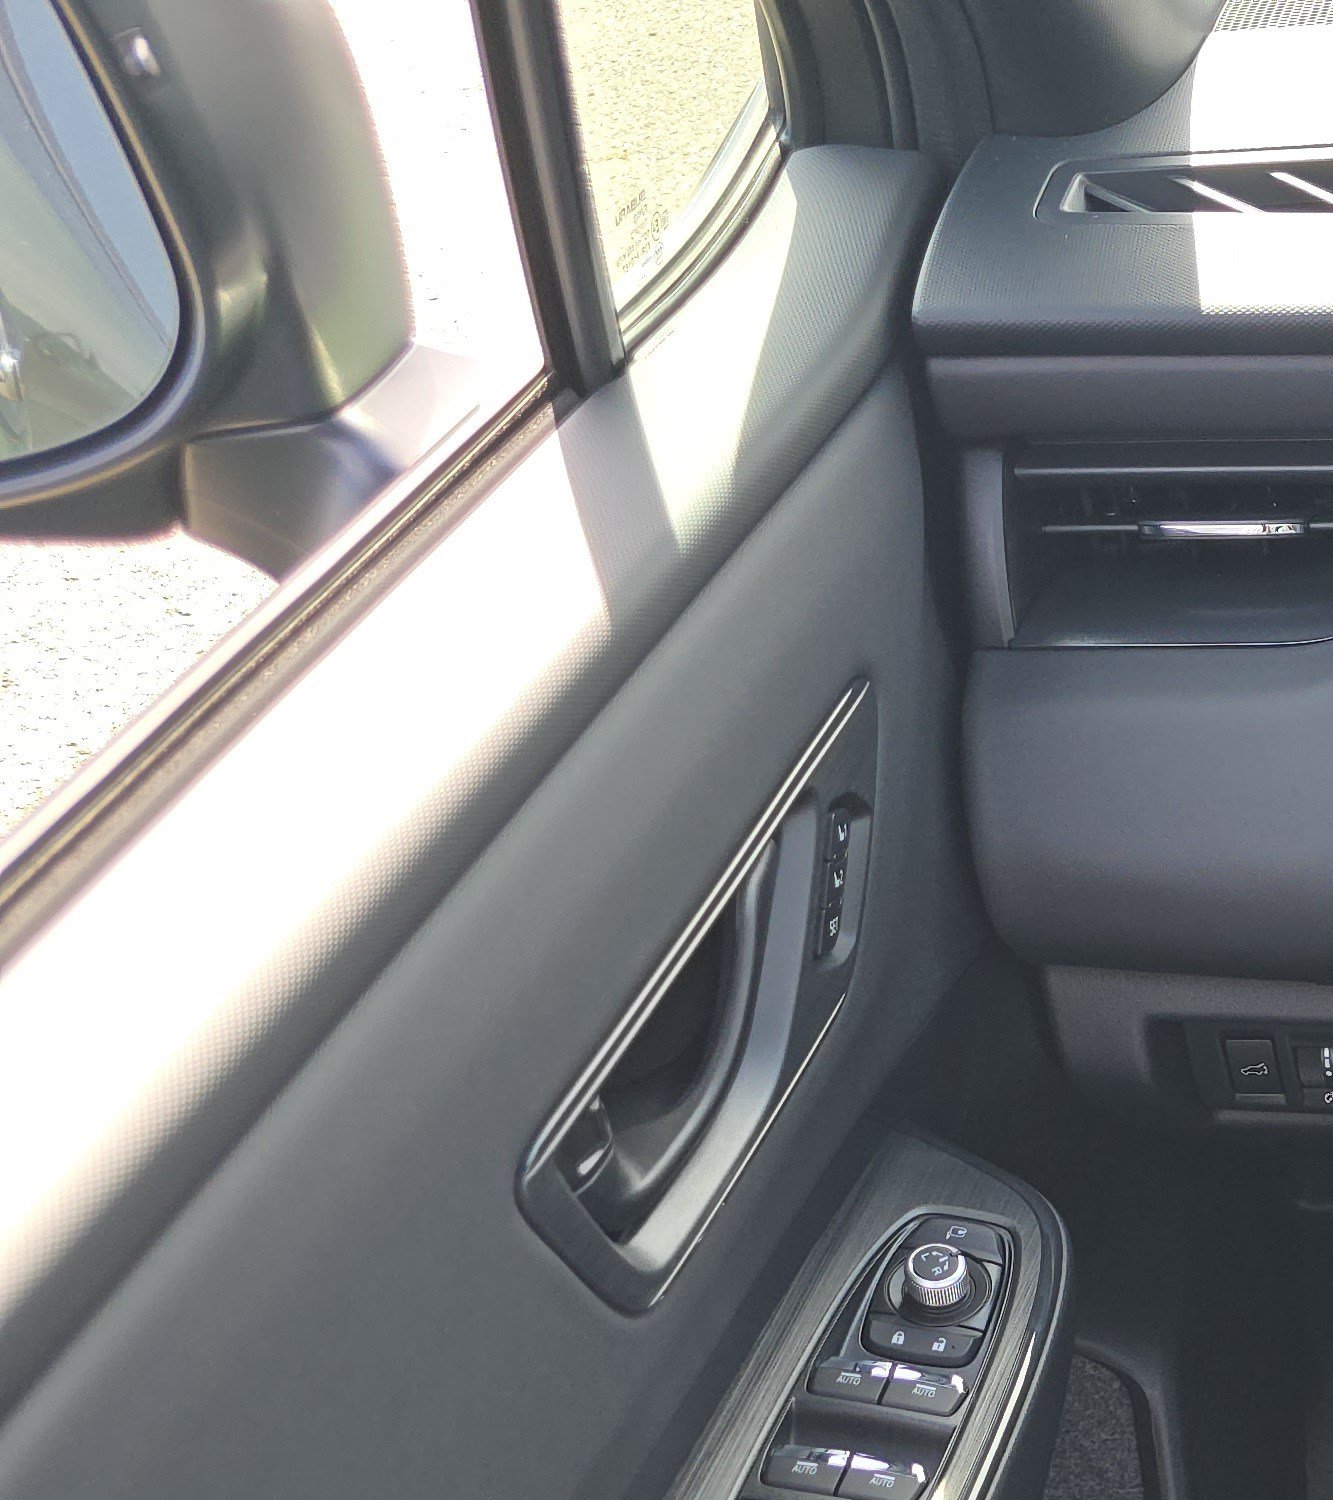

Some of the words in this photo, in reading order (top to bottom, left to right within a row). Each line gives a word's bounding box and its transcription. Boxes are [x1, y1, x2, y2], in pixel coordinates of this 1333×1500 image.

[836, 1375, 861, 1386] AUTO
[911, 1386, 936, 1398] AUTO
[792, 1465, 817, 1475] AUTO
[869, 1477, 895, 1488] AUTO
